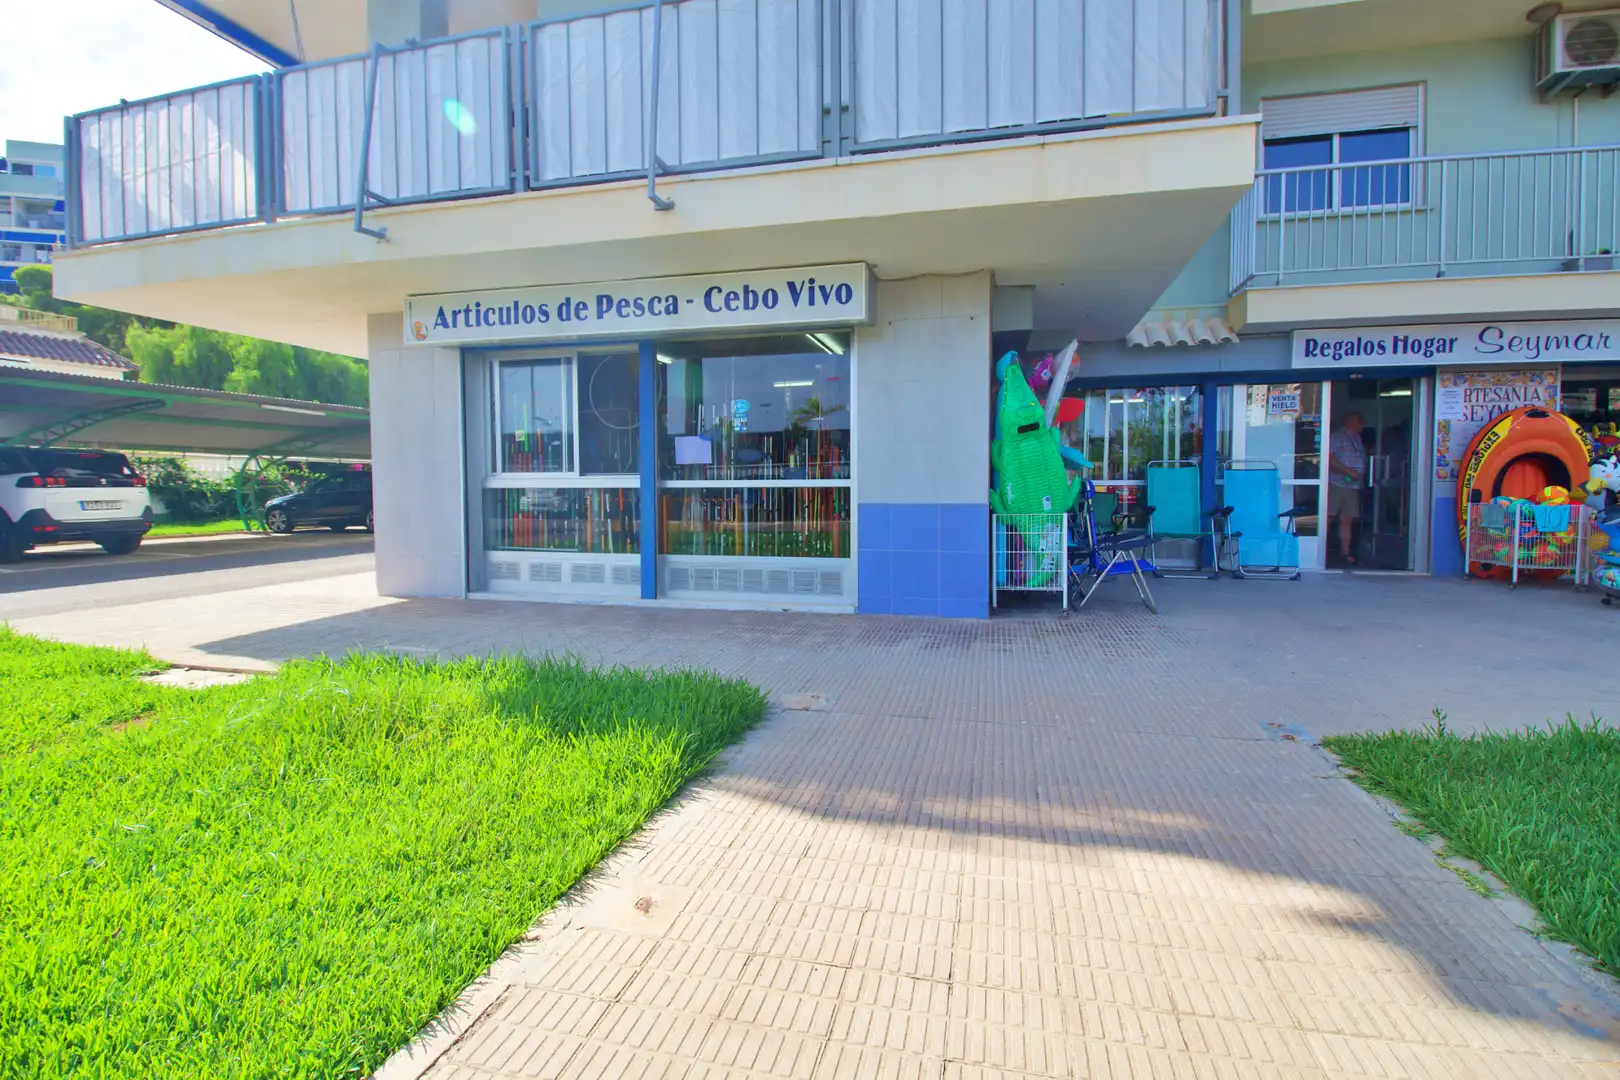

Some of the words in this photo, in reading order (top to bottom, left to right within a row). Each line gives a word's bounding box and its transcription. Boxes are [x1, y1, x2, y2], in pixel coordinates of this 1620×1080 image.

[433, 300, 550, 330] Articulos
[557, 296, 589, 322] de
[596, 293, 679, 321] Pesca
[703, 284, 779, 313] Cebo
[786, 277, 853, 308] Vivo
[1304, 336, 1387, 361] Regalos
[1391, 334, 1459, 358] Hogar
[1474, 325, 1612, 360] Seymar
[1463, 386, 1542, 403] RTESANIA
